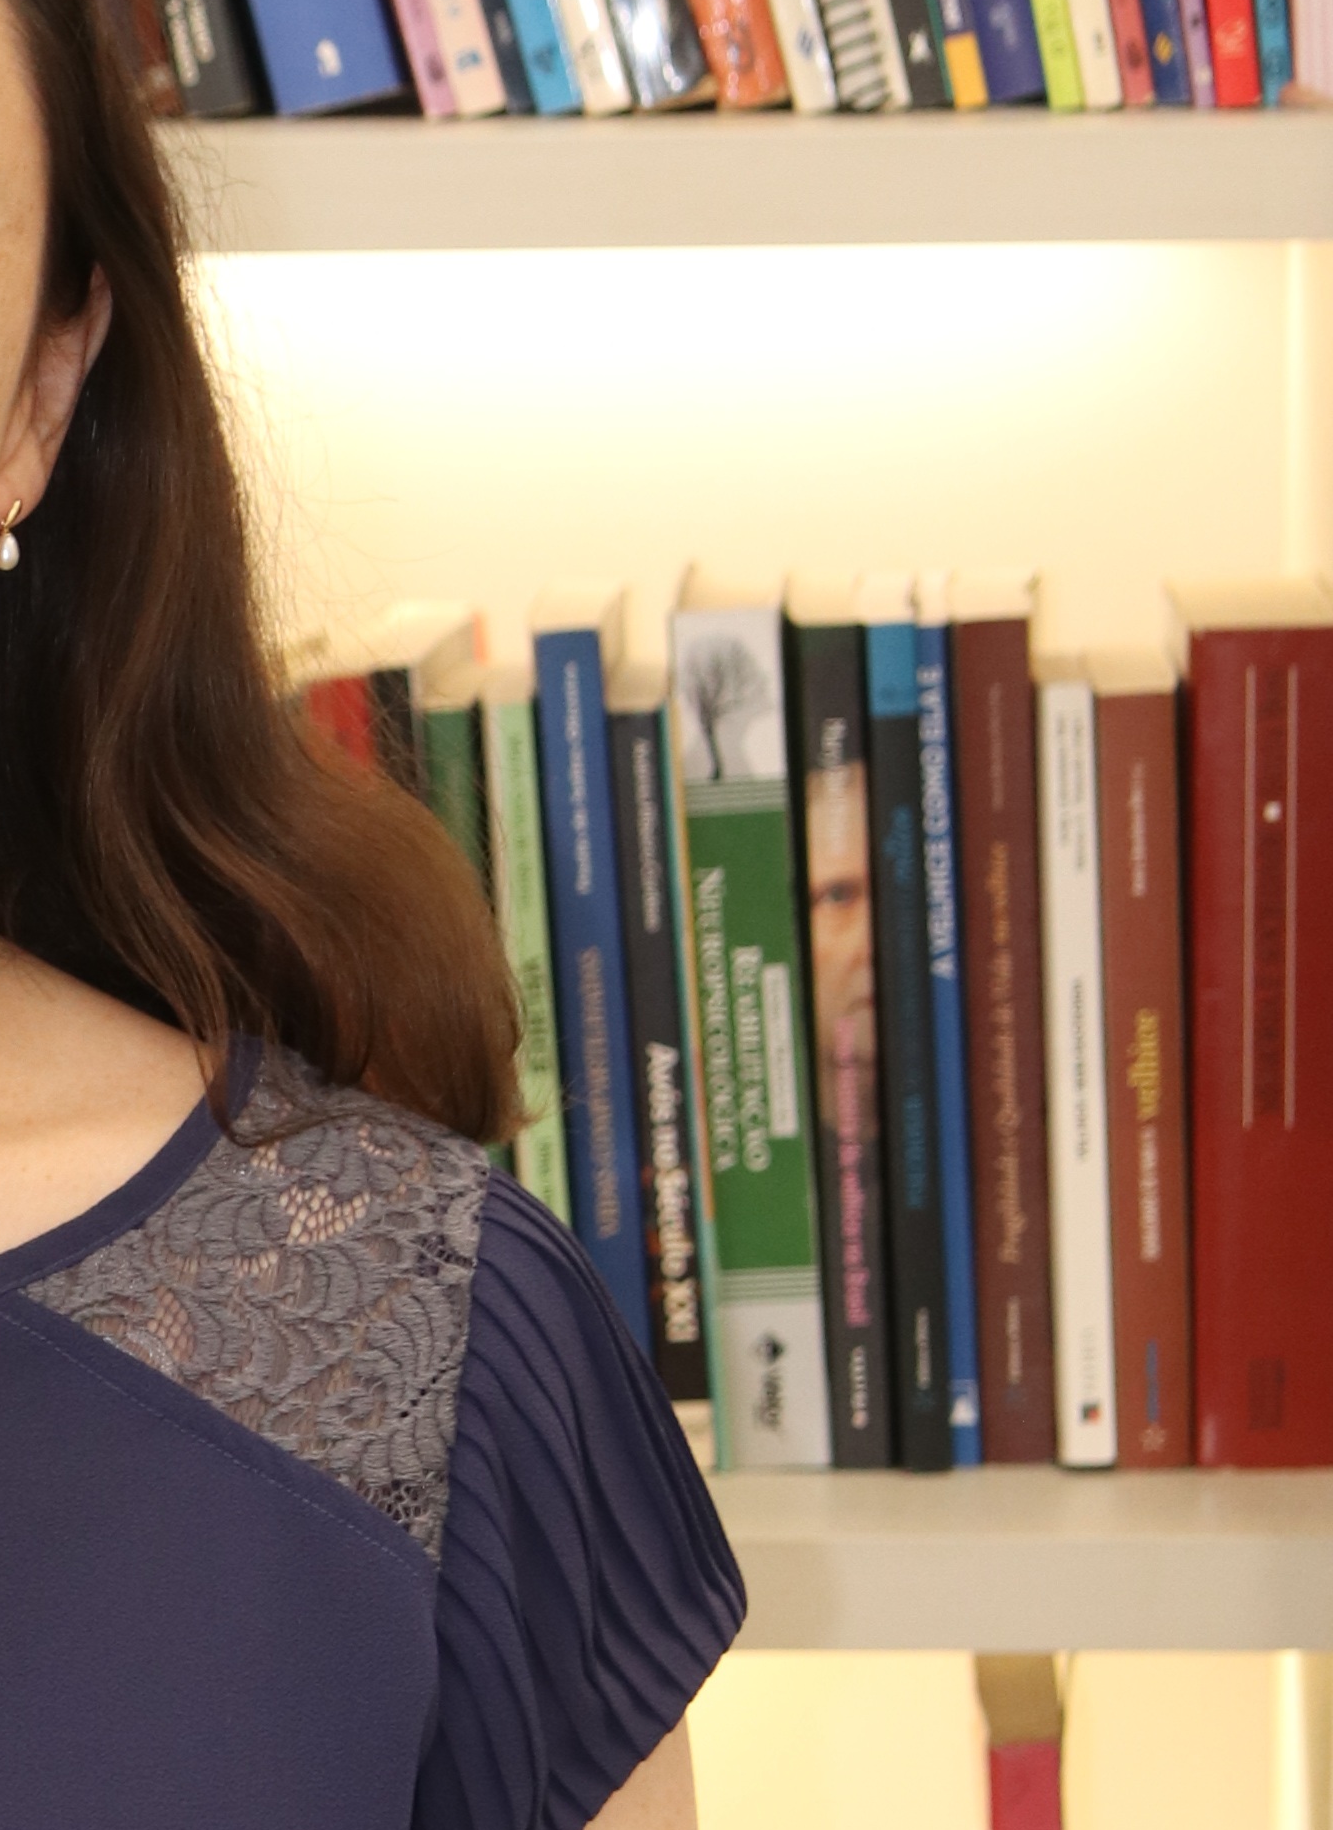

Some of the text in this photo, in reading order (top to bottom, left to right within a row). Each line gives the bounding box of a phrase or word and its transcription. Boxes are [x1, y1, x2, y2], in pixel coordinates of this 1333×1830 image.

[1121, 1007, 1163, 1123] velhice
[639, 1047, 700, 1345] Avós no Século XXI
